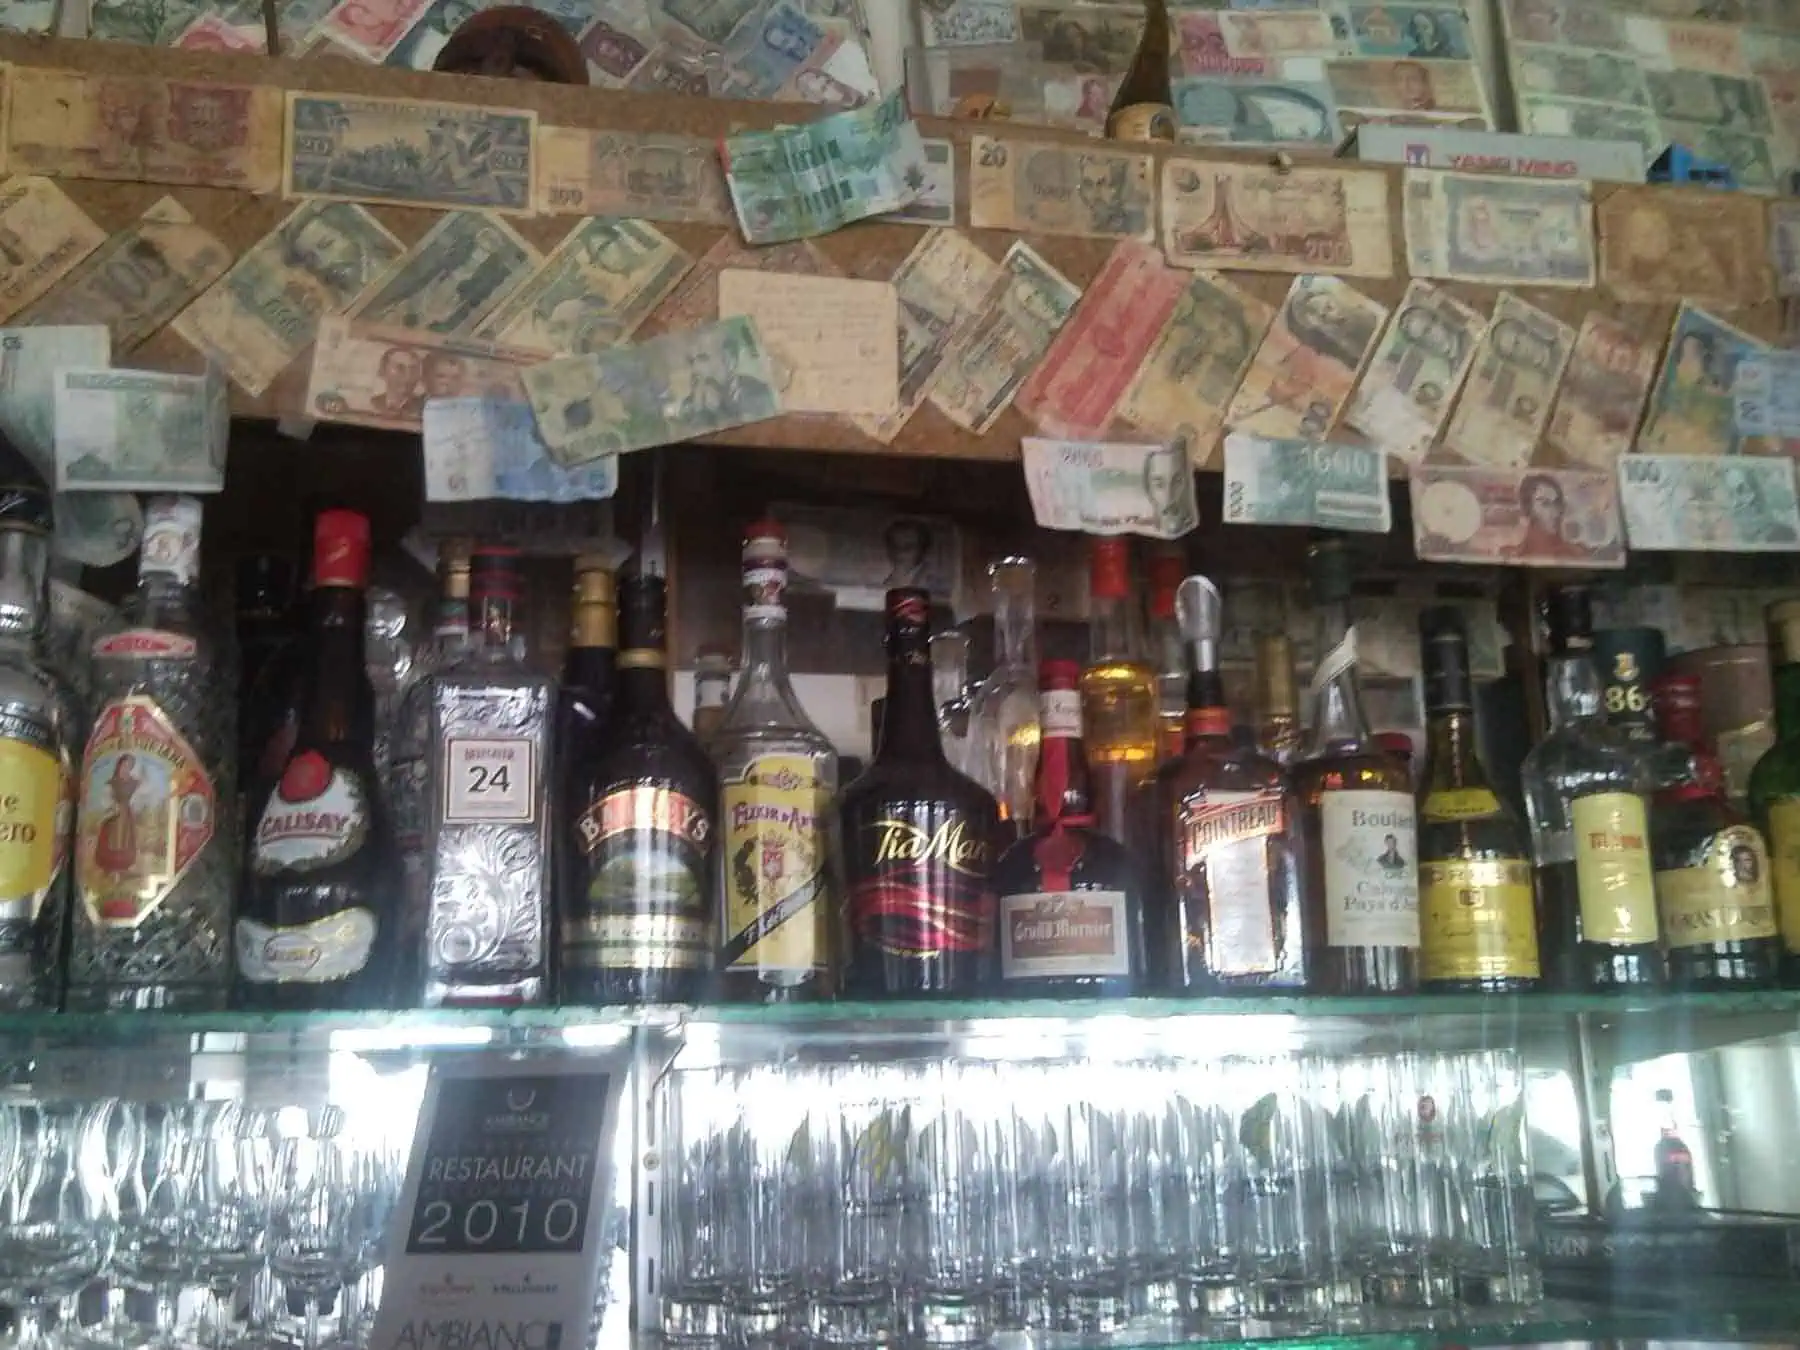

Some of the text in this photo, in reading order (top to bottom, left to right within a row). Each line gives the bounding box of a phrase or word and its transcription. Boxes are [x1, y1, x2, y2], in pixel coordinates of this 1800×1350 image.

[1605, 685, 1646, 713] 86
[467, 764, 512, 794] 24
[870, 819, 930, 867] Tia
[428, 1153, 590, 1182] RESTAURANT
[417, 1198, 579, 1245] 2010
